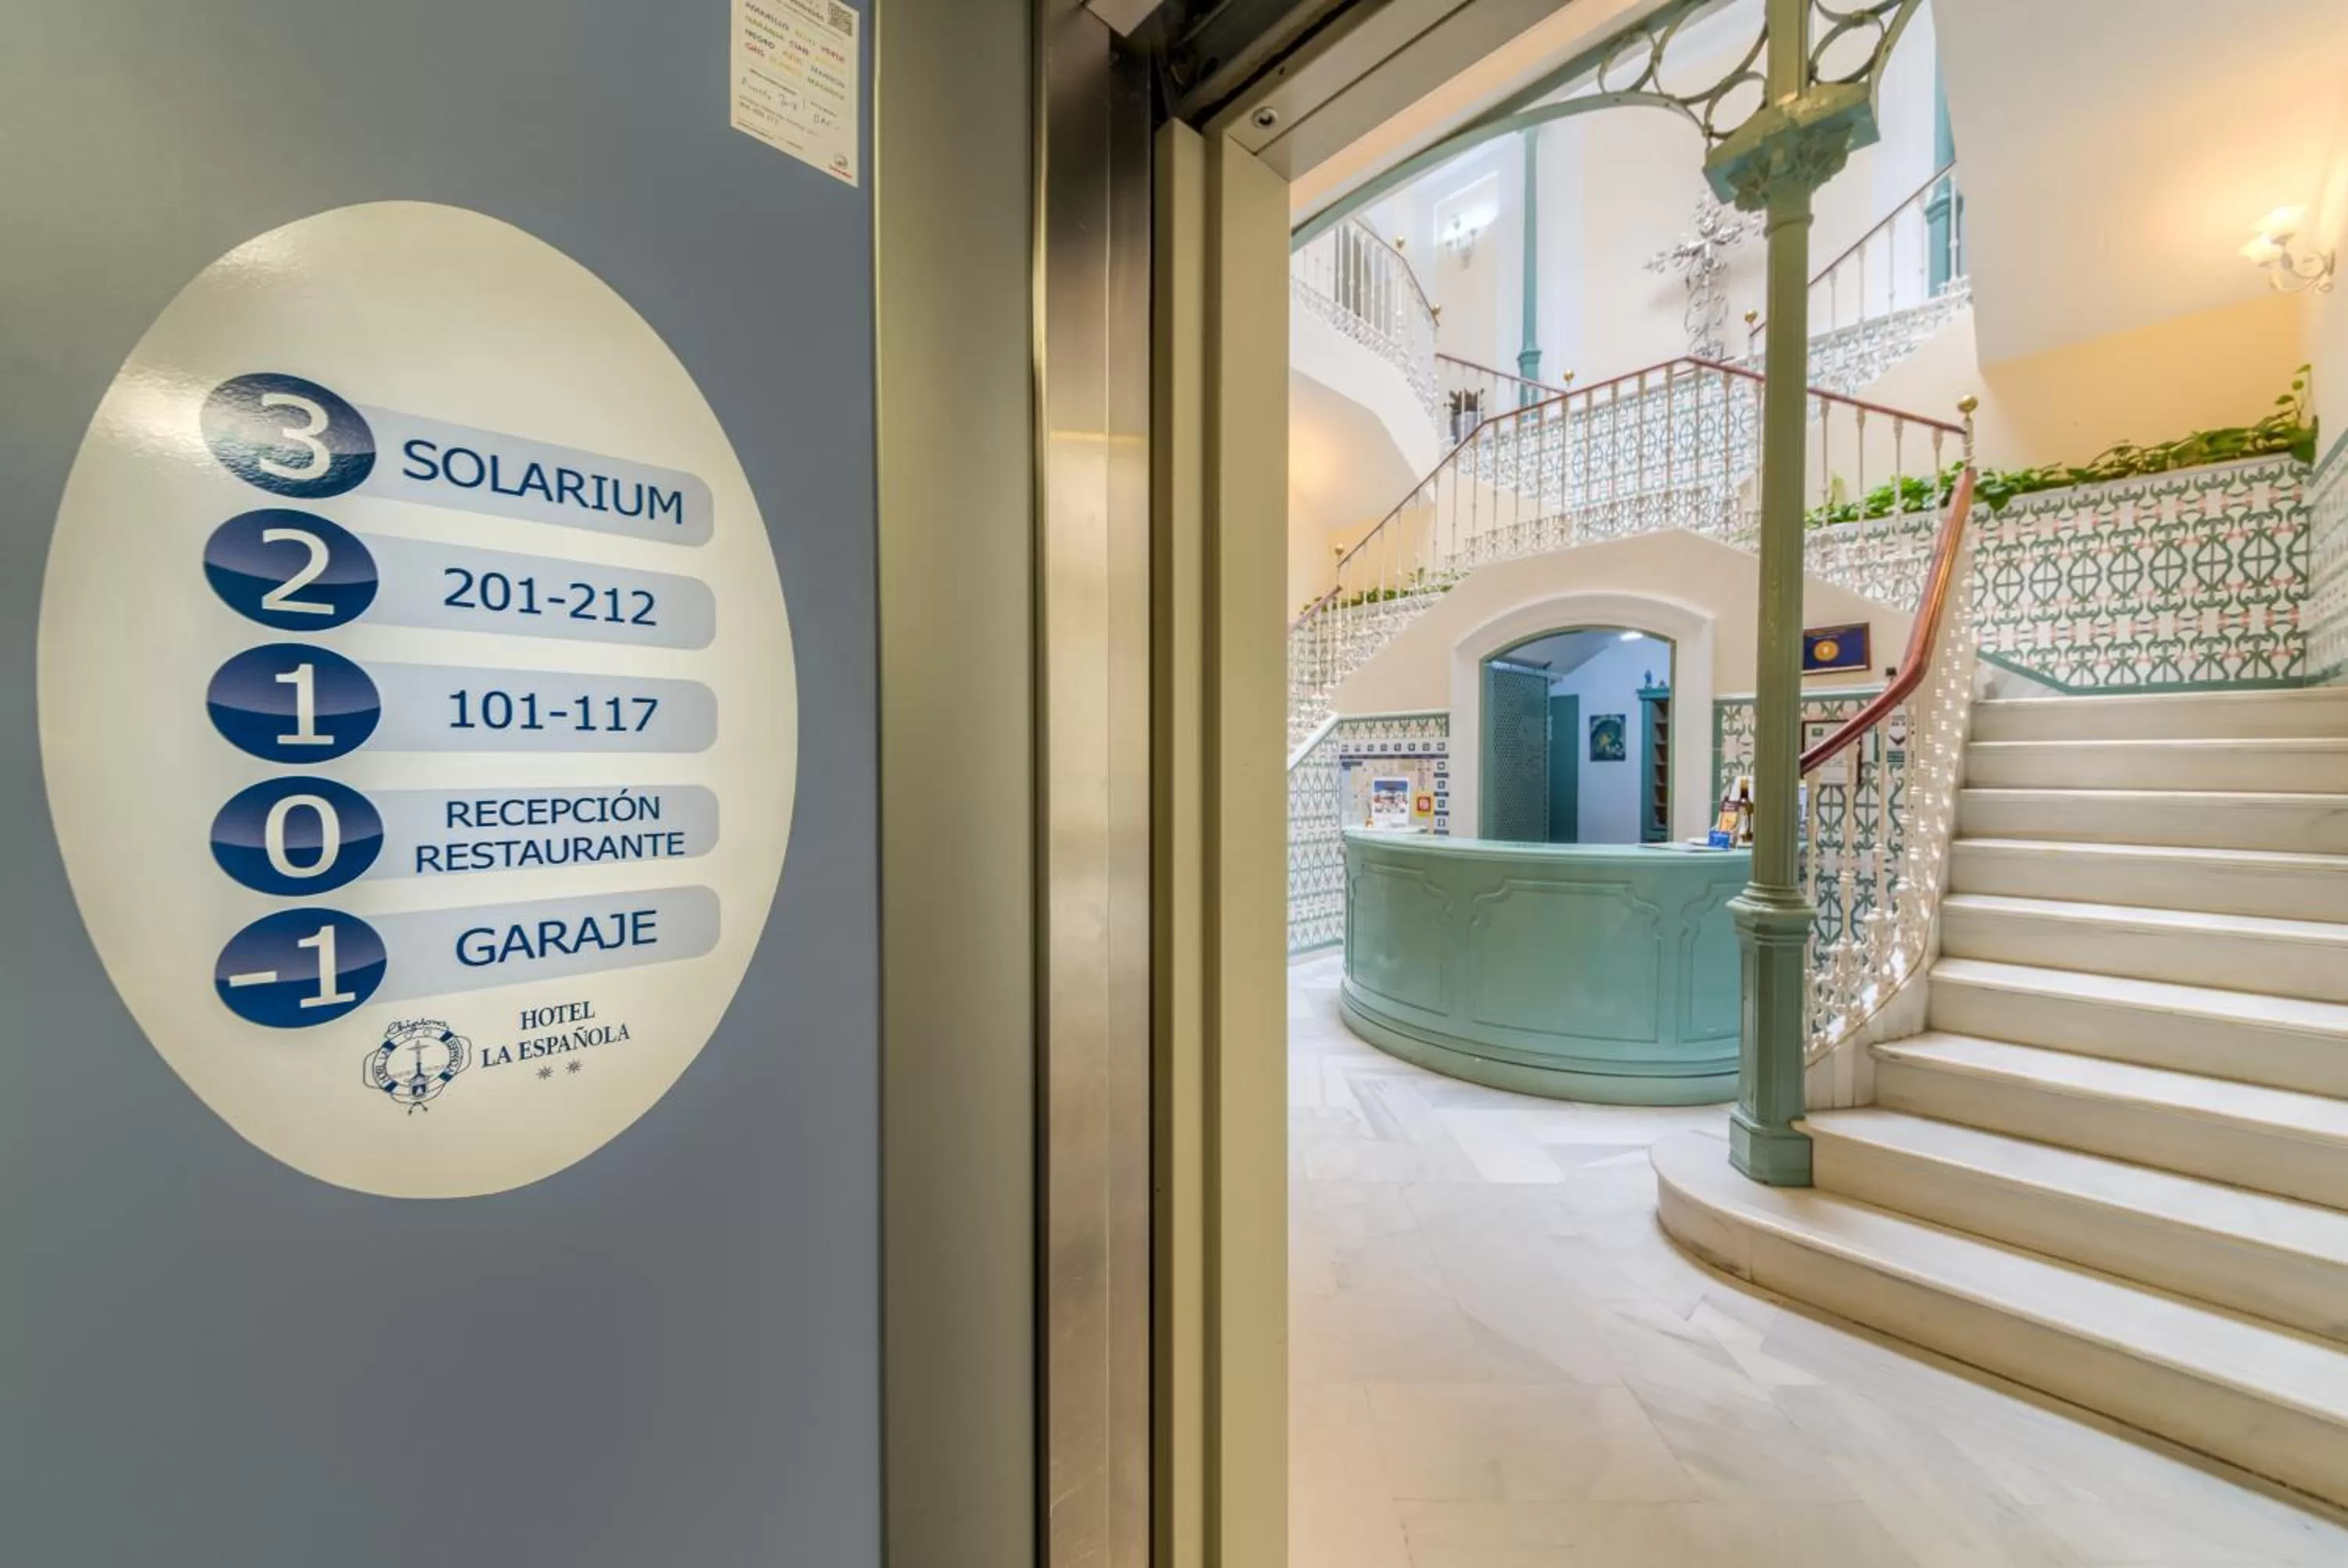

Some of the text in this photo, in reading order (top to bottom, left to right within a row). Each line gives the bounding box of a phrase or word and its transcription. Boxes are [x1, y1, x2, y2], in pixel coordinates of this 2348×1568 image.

[259, 393, 684, 524] 3 SOLARIUM
[261, 527, 657, 626] 2 201-212
[275, 663, 659, 745] 1 101-117
[264, 789, 661, 879] 0 RECEPCIÓN
[415, 832, 686, 873] RESTAURANTE
[228, 910, 659, 1009] -1 GARAJE
[481, 1045, 513, 1068] LA
[518, 1023, 631, 1061] ESPAÑOLA
[520, 1001, 596, 1030] HOTEL
